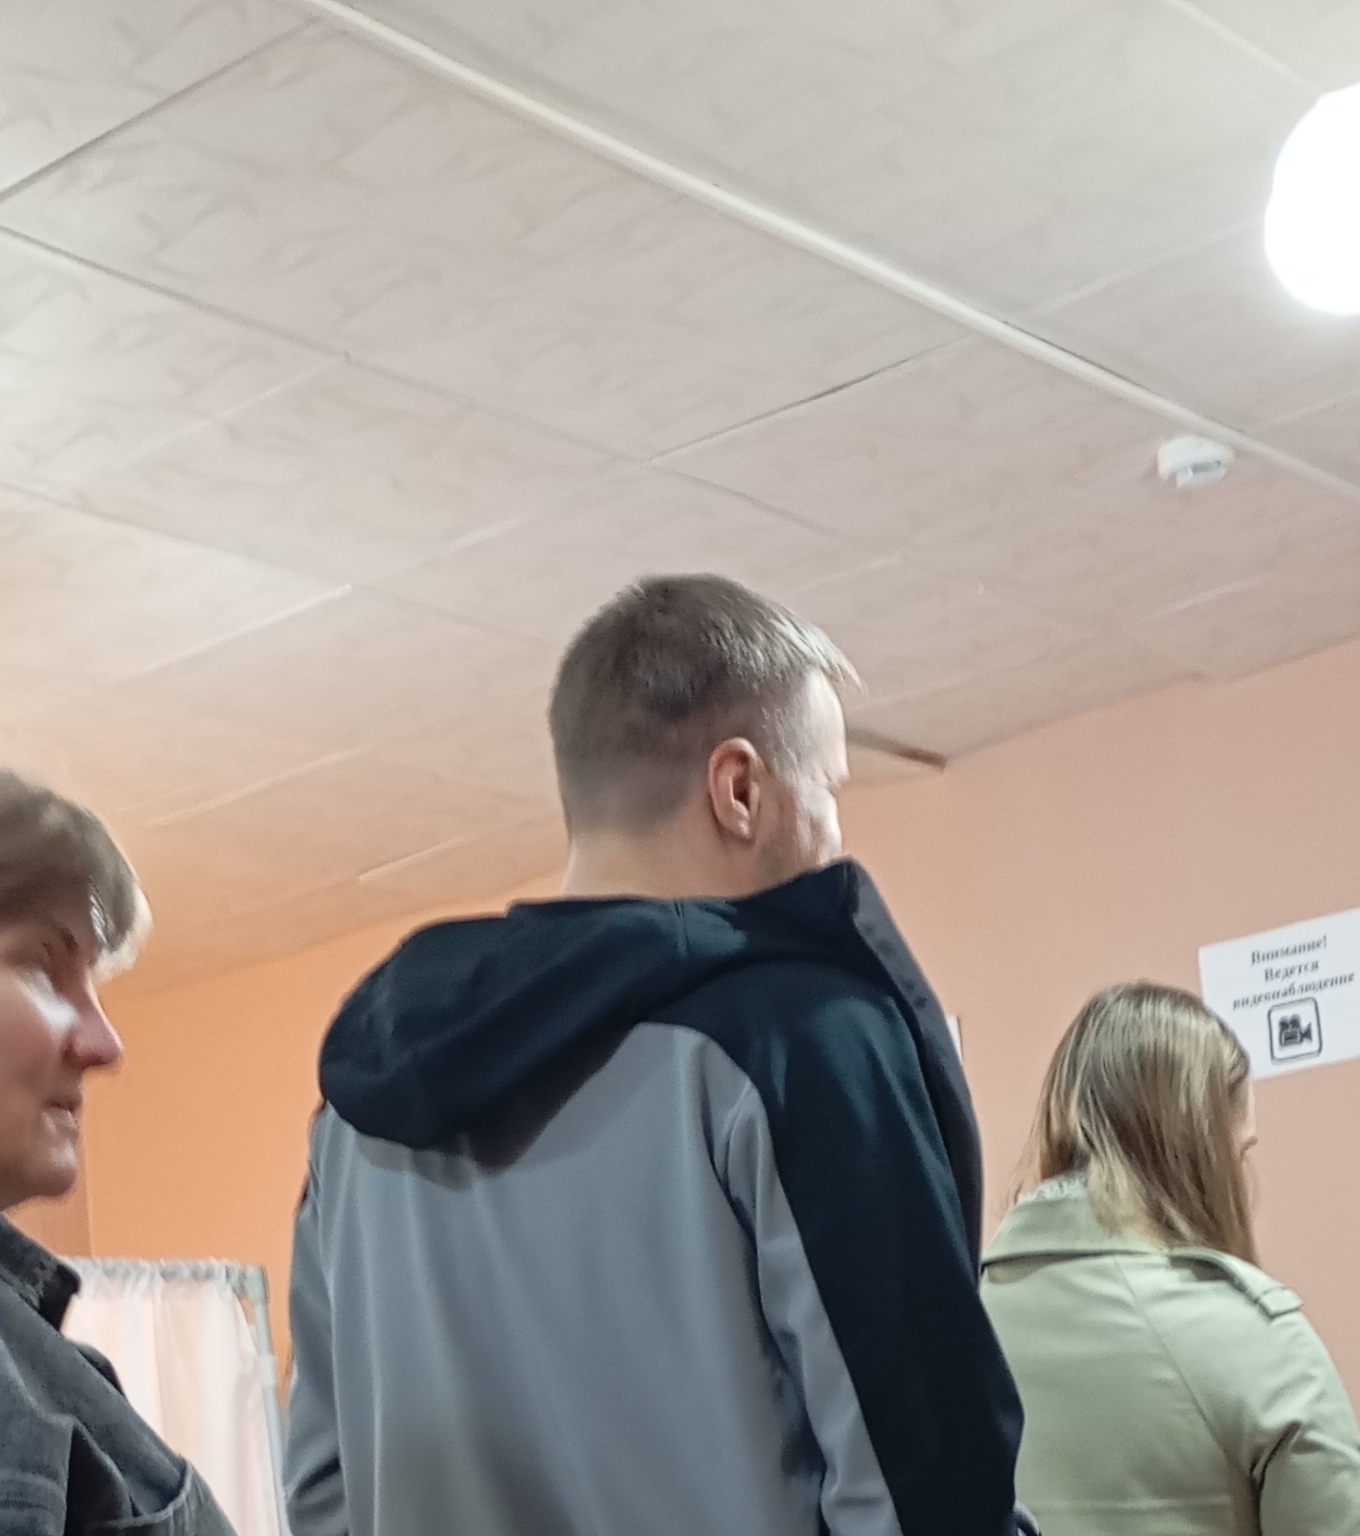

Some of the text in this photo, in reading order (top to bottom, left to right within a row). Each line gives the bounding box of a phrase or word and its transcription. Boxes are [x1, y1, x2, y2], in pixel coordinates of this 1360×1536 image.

[1251, 935, 1327, 966] Внимание!
[1264, 960, 1319, 984] Ведется
[1233, 972, 1355, 1011] видеонаблюдение
